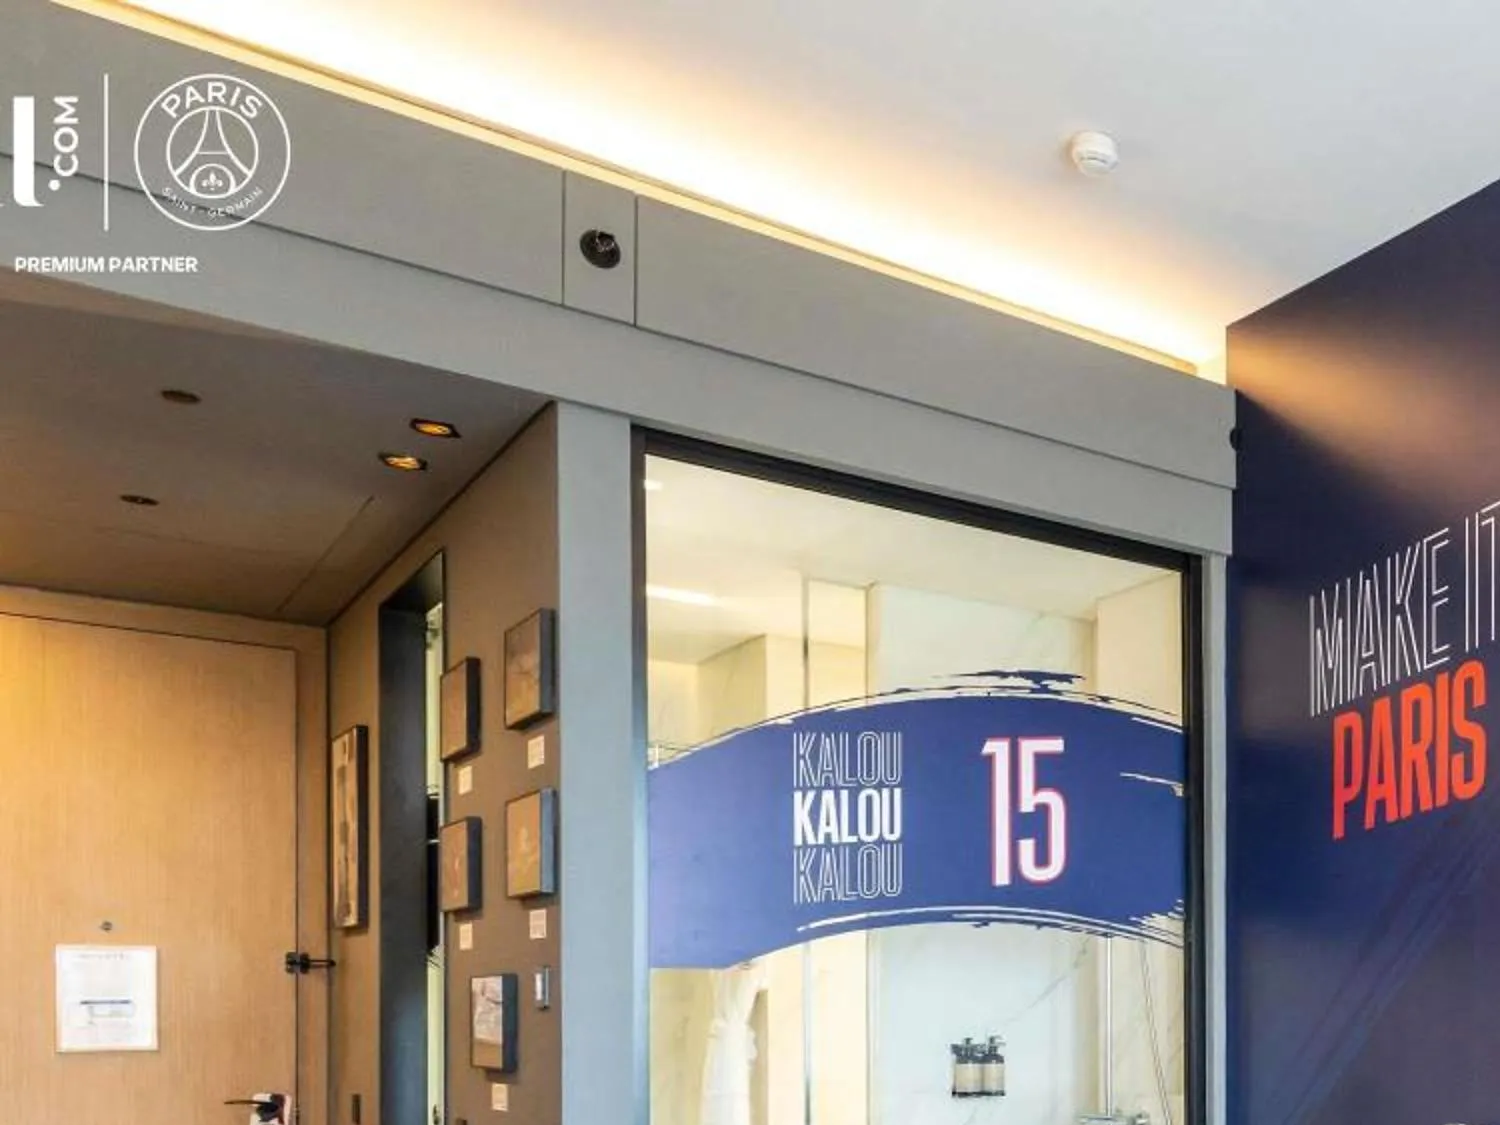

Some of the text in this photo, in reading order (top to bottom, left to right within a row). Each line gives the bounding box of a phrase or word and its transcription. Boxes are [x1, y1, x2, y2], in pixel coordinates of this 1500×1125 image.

[1309, 526, 1449, 717] MAKE
[793, 731, 902, 789] KALOU
[1332, 659, 1487, 840] PARIS
[793, 788, 902, 847] KALOU
[981, 736, 1067, 887] 15
[793, 845, 903, 905] KALOU
